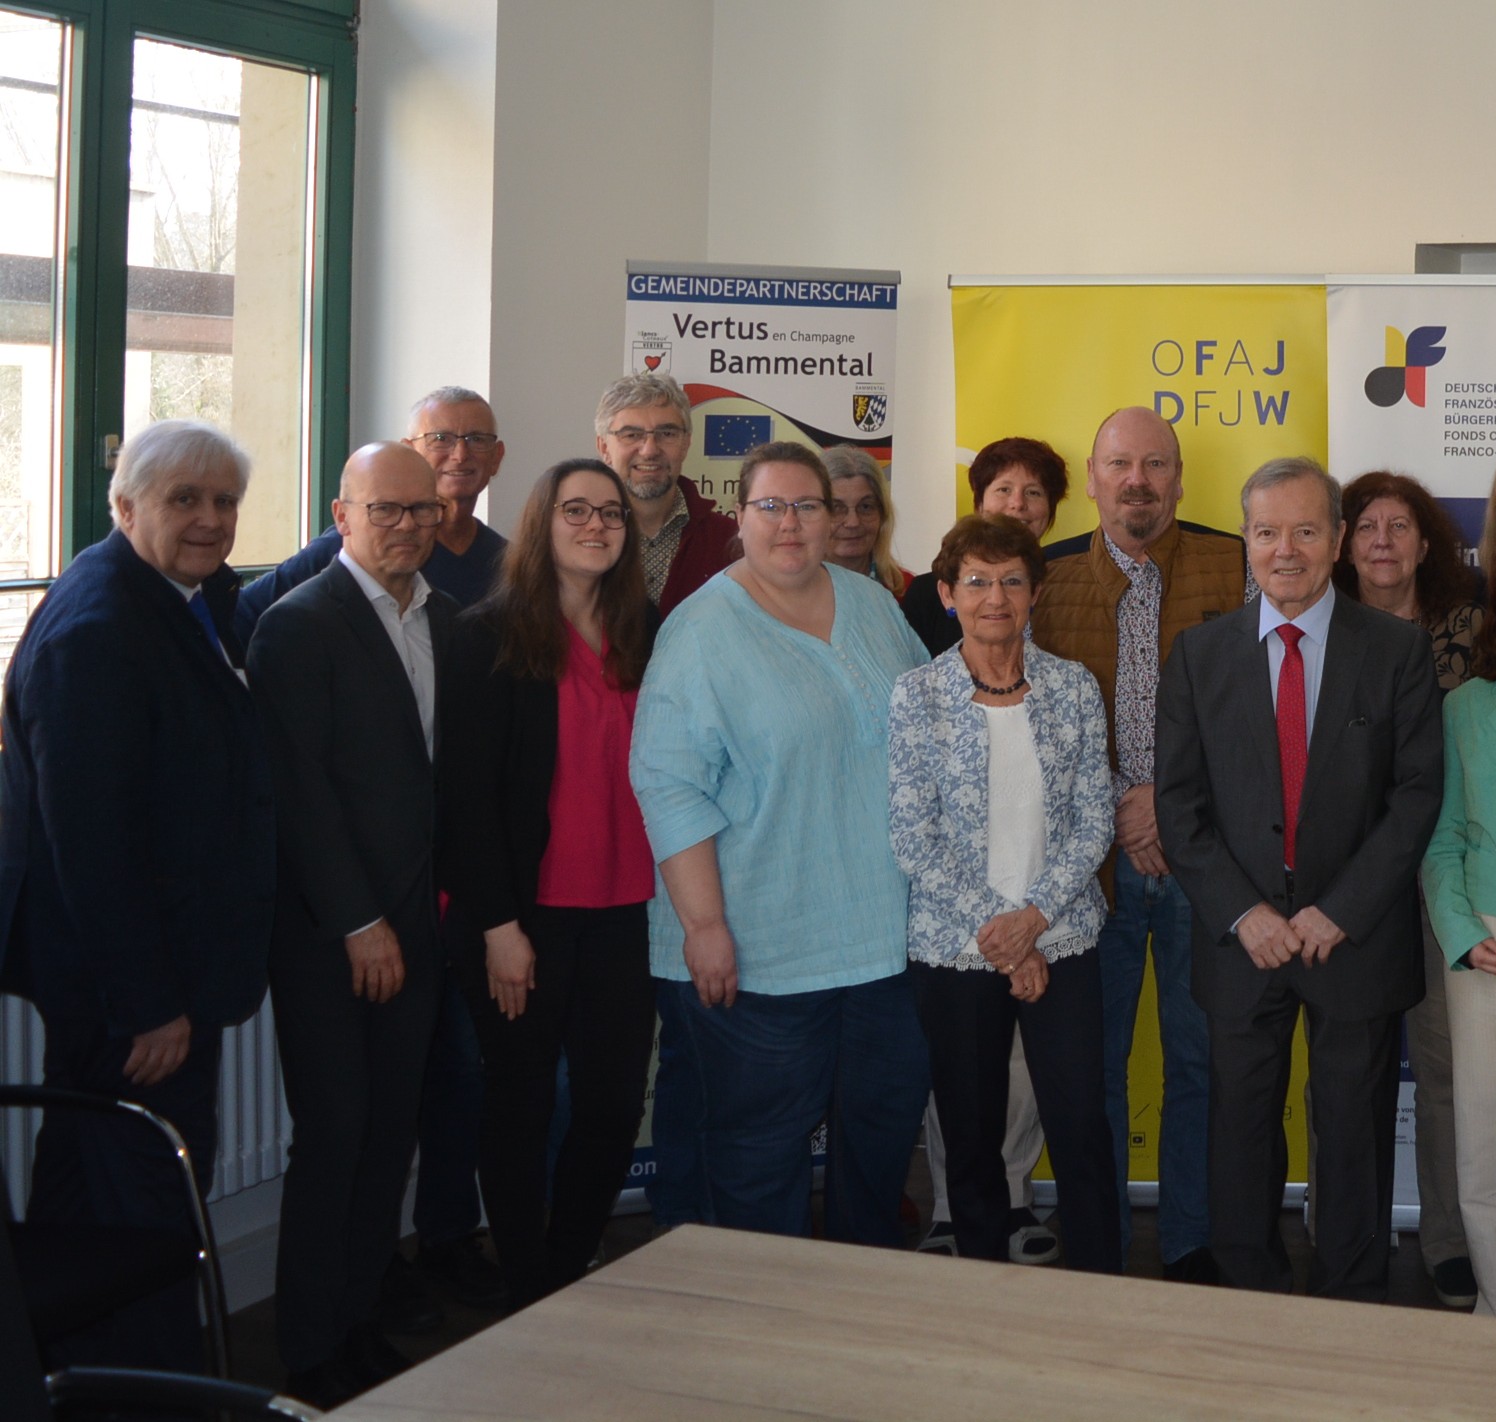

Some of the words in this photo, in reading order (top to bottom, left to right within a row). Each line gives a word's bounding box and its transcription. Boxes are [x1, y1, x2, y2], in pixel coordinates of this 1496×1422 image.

[631, 275, 895, 303] GEMEINDEPARTNERSCHAFT
[673, 313, 768, 341] Vertus
[772, 332, 787, 342] en
[790, 331, 855, 345] Champagne
[710, 349, 873, 377] Bammental
[1152, 340, 1285, 376] OFAJ
[1154, 390, 1290, 426] DFJW
[1444, 431, 1486, 441] FONDS
